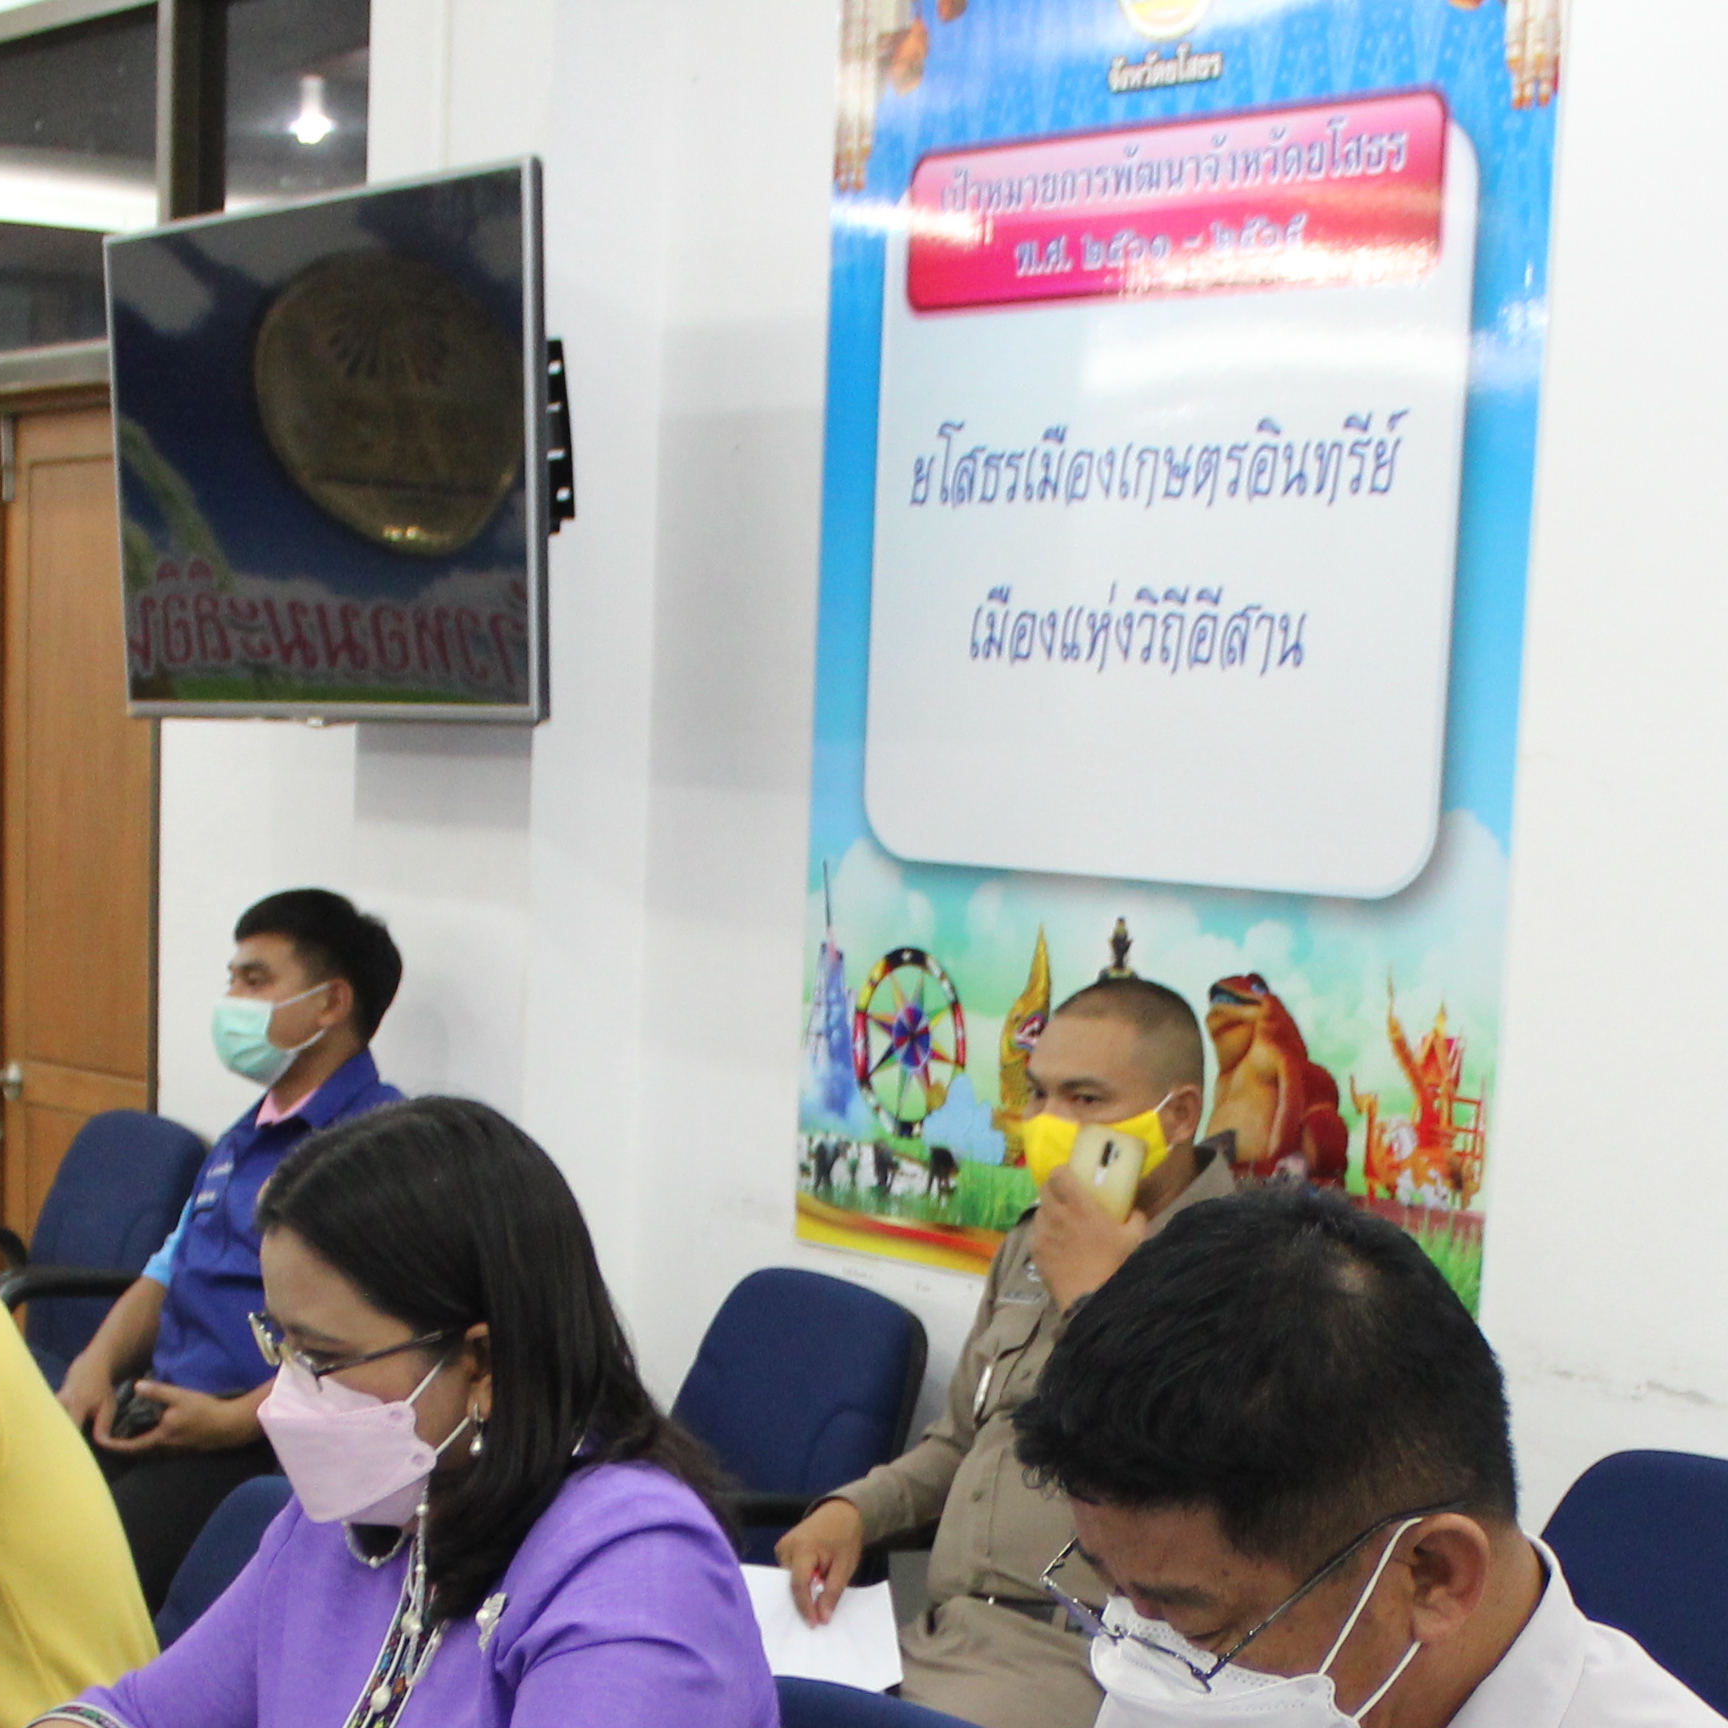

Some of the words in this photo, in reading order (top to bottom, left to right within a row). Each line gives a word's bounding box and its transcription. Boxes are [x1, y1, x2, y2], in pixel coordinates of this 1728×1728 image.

[1108, 42, 1223, 93] จังหวัดยโสธร
[939, 115, 1408, 212] เป้าหมายการพัฒนาจังหวัดยโสธร
[1015, 236, 1071, 276] พ.ศ.
[1082, 229, 1169, 270] ๒๕๖๑
[908, 410, 1410, 510] ยโสธรเมืองเกษตรอินทรีย์
[968, 582, 1306, 677] เมืองแห่งวิถีอีสาน
